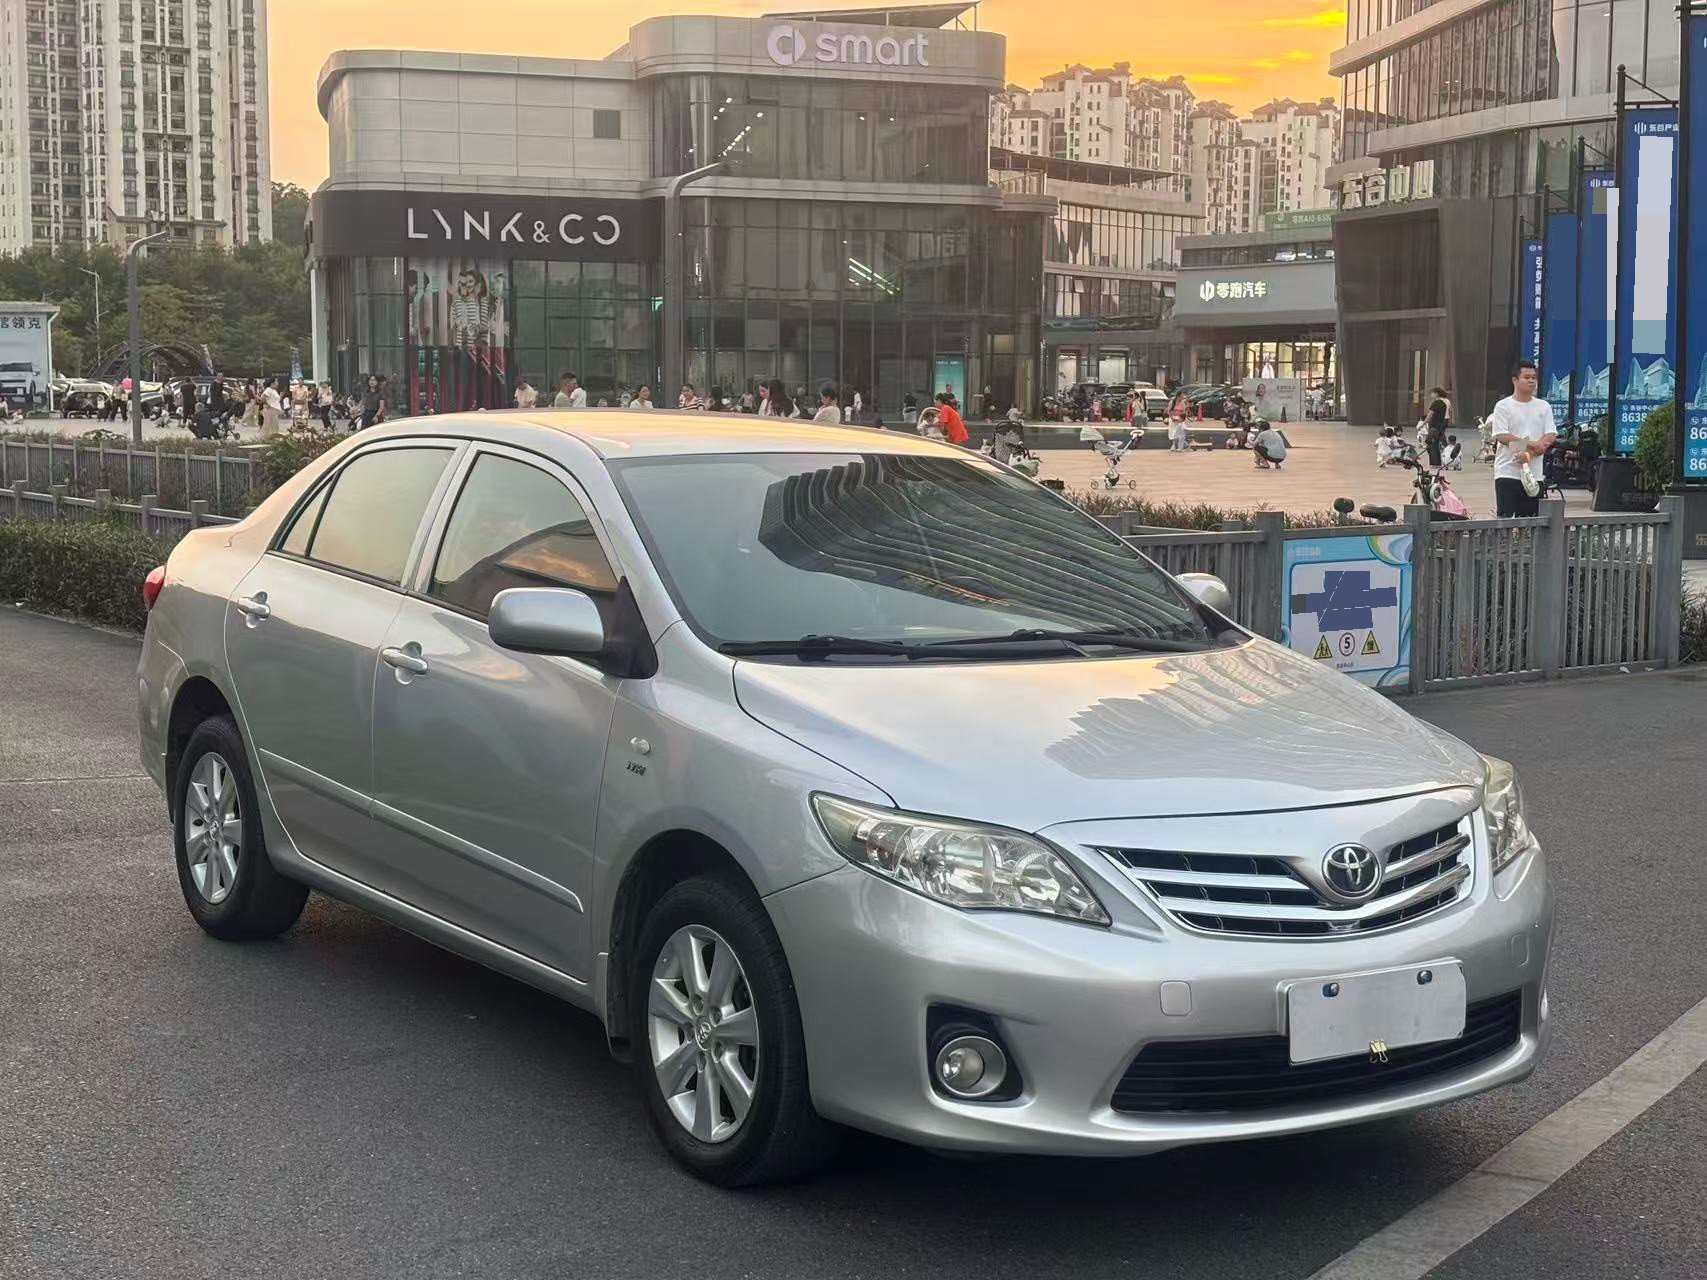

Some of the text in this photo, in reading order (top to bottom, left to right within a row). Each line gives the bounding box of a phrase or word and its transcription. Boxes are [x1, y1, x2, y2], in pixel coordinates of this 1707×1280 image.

[815, 32, 929, 67] smart
[1216, 280, 1267, 299] 零跑汽车
[1690, 427, 1707, 440] 86
[1690, 458, 1707, 471] 86
